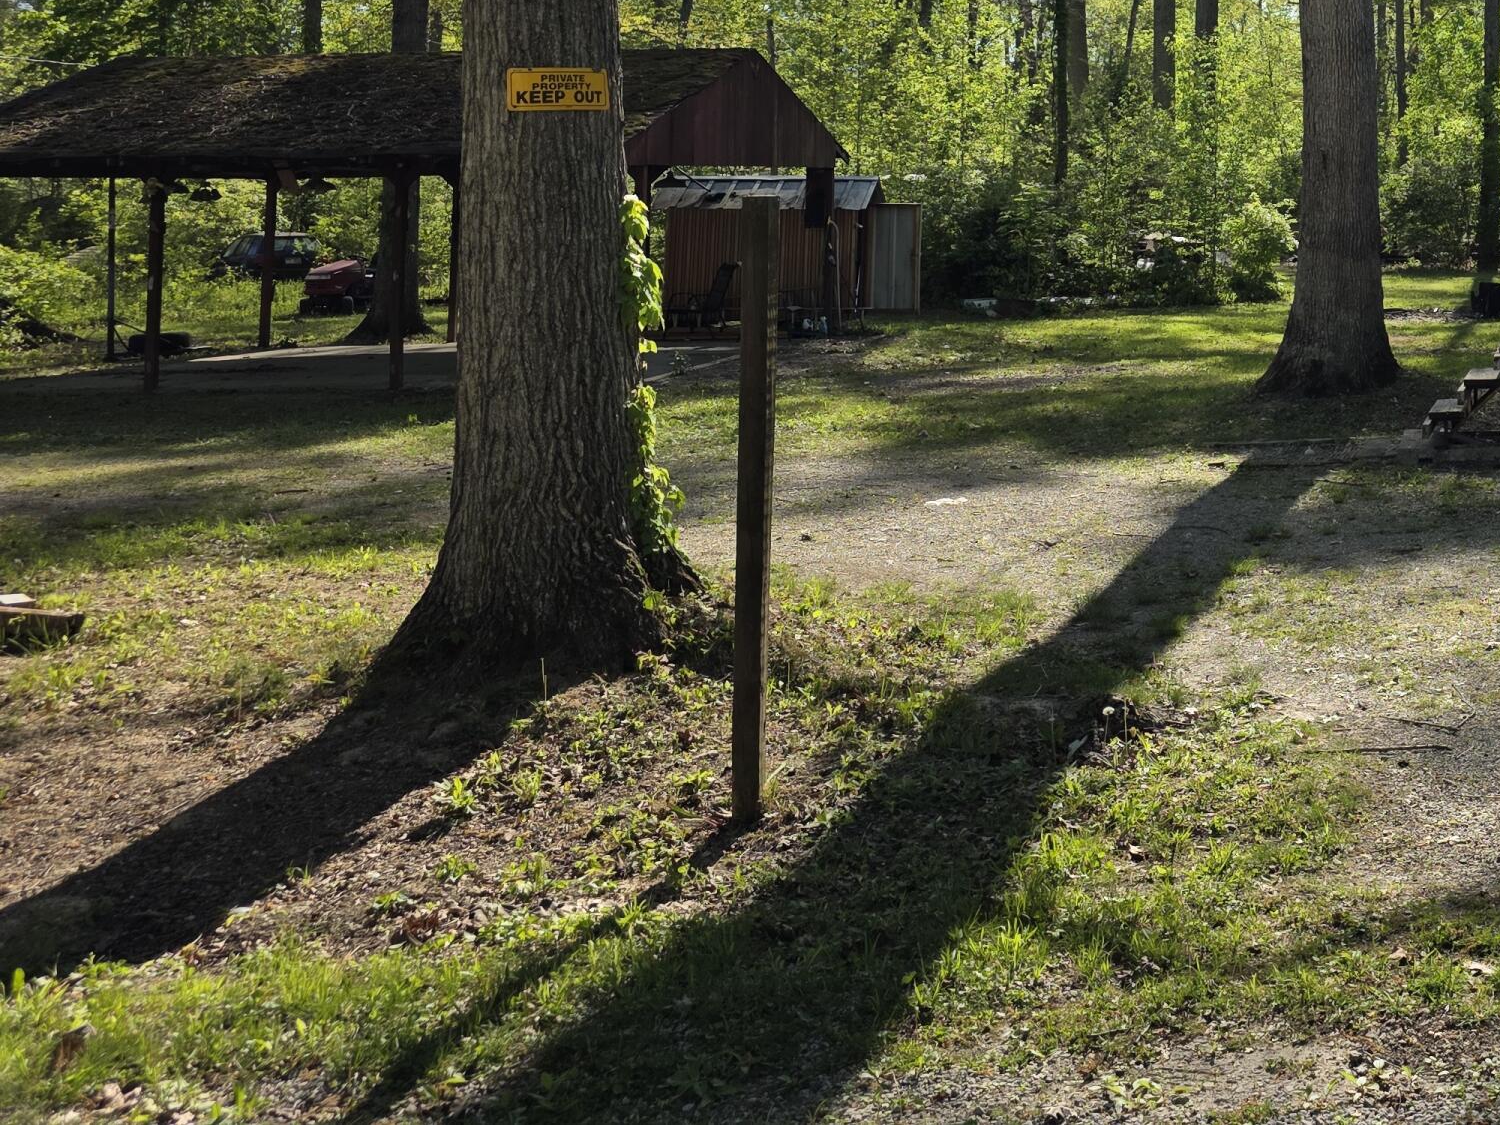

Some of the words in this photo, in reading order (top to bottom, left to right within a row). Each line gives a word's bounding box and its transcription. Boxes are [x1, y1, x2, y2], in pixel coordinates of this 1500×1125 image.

[541, 74, 585, 82] PRIVATE
[532, 82, 591, 90] PROPERTY
[516, 90, 566, 104] KEEP
[574, 90, 602, 103] OUT
